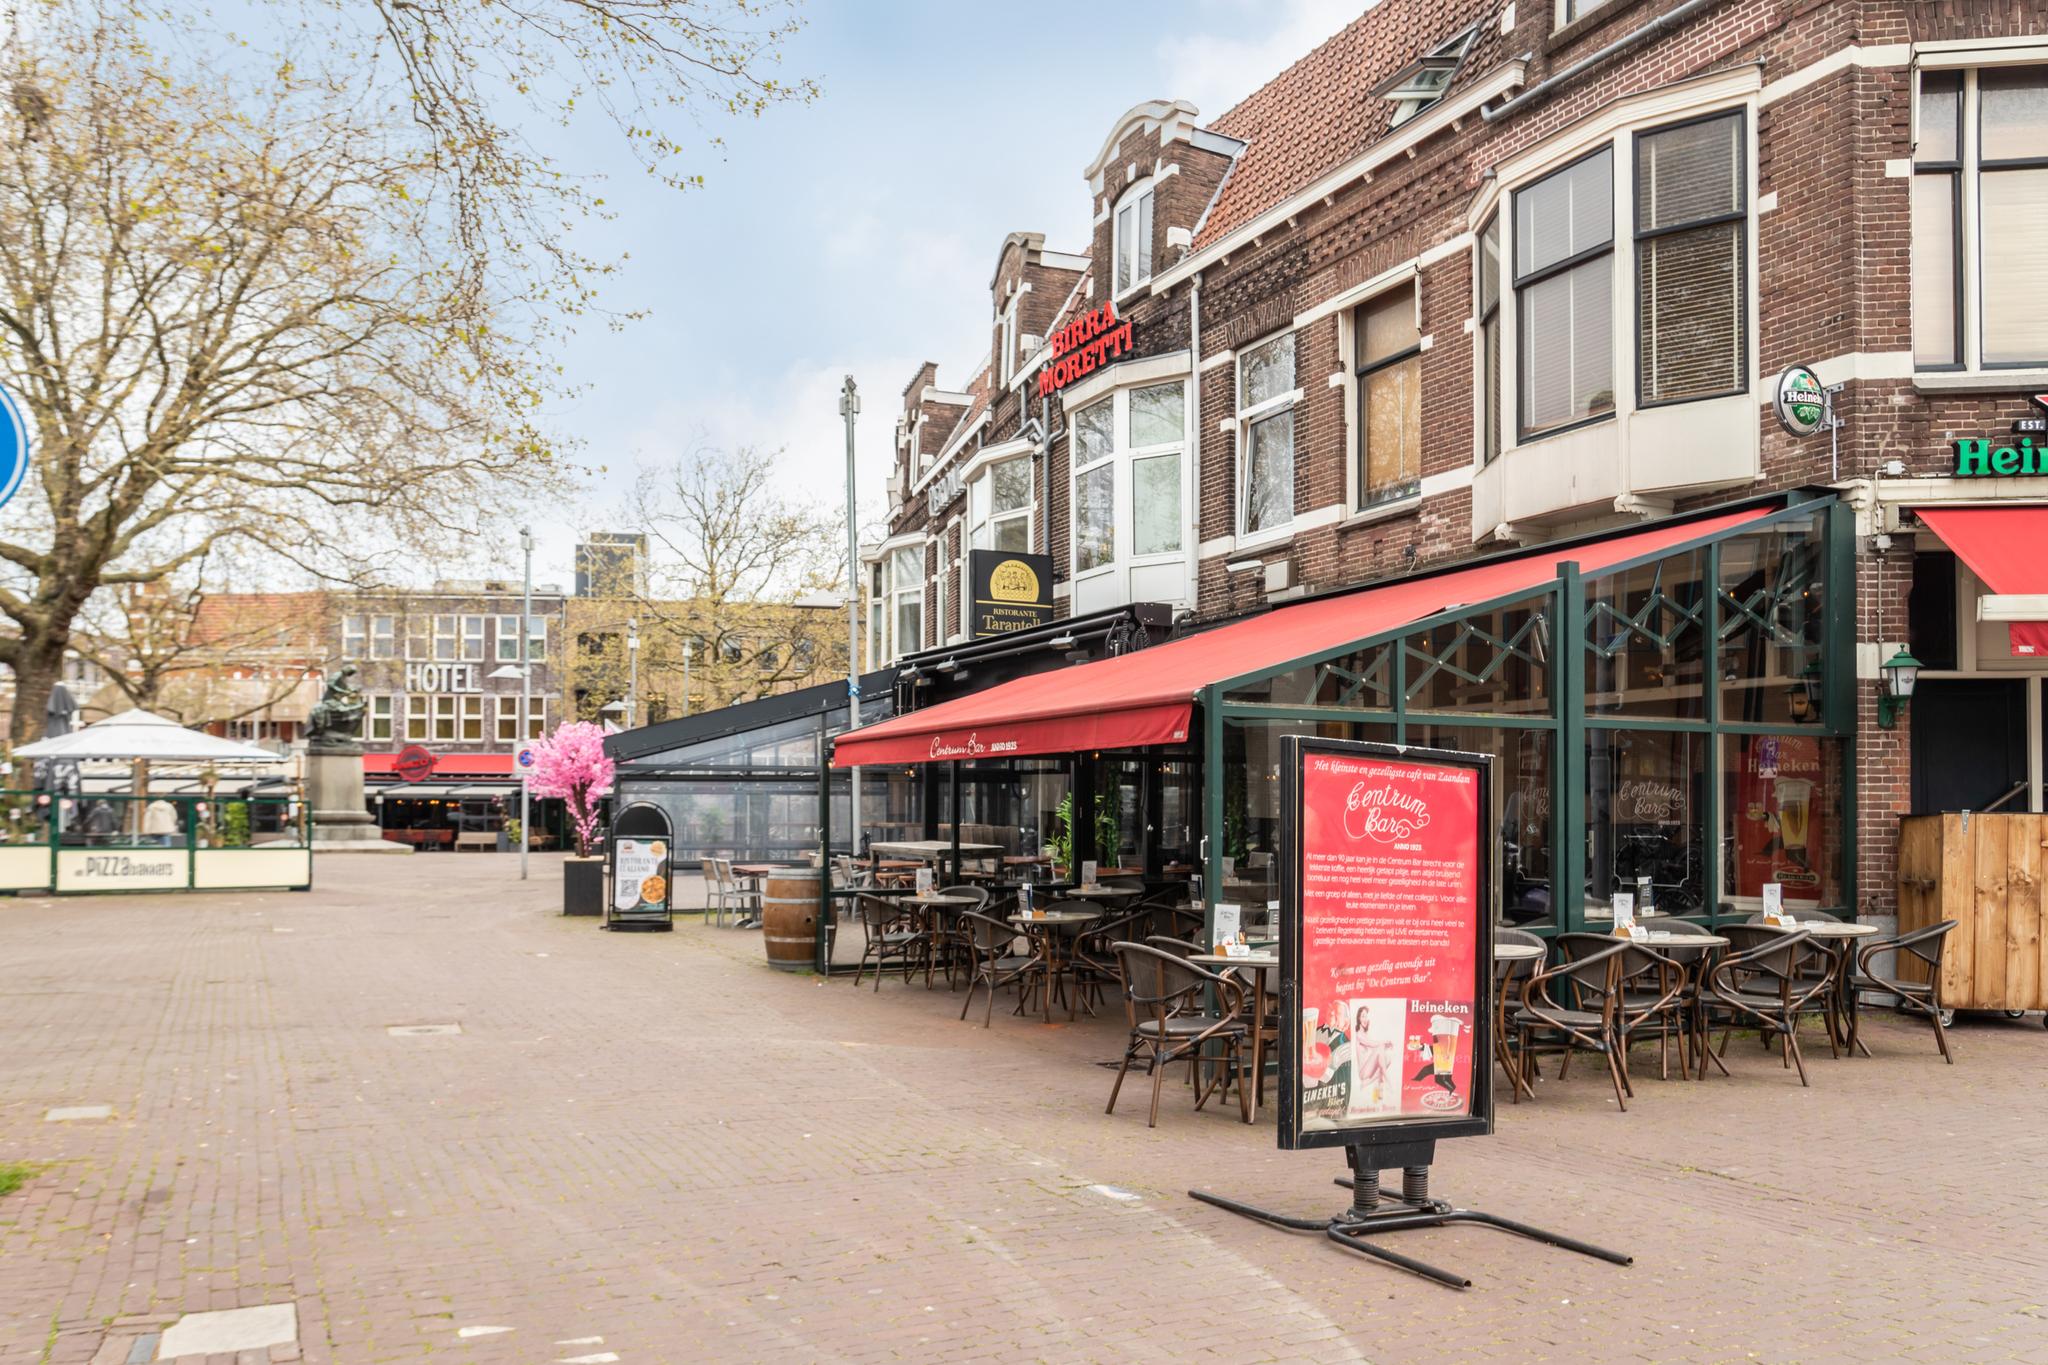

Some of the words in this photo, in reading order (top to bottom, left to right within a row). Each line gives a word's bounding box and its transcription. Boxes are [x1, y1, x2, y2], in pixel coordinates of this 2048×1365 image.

[1051, 299, 1116, 360] BIRRA
[1039, 321, 1133, 398] MORETTI
[2021, 420, 2044, 430] EST.
[993, 607, 1037, 617] RISTORANTE
[405, 663, 484, 692] HOTEL
[930, 736, 967, 758] Centrum
[967, 732, 986, 755] Bar
[1314, 760, 1329, 771] Het
[1330, 760, 1358, 774] kleinste
[1359, 765, 1368, 775] en
[1423, 772, 1437, 780] van
[1438, 772, 1470, 784] Zaandam
[1346, 781, 1427, 817] Centrum
[1620, 780, 1682, 802] Centrum
[1635, 798, 1664, 815] Bar
[1364, 806, 1400, 833] Bar
[1411, 1000, 1469, 1014] Heineken
